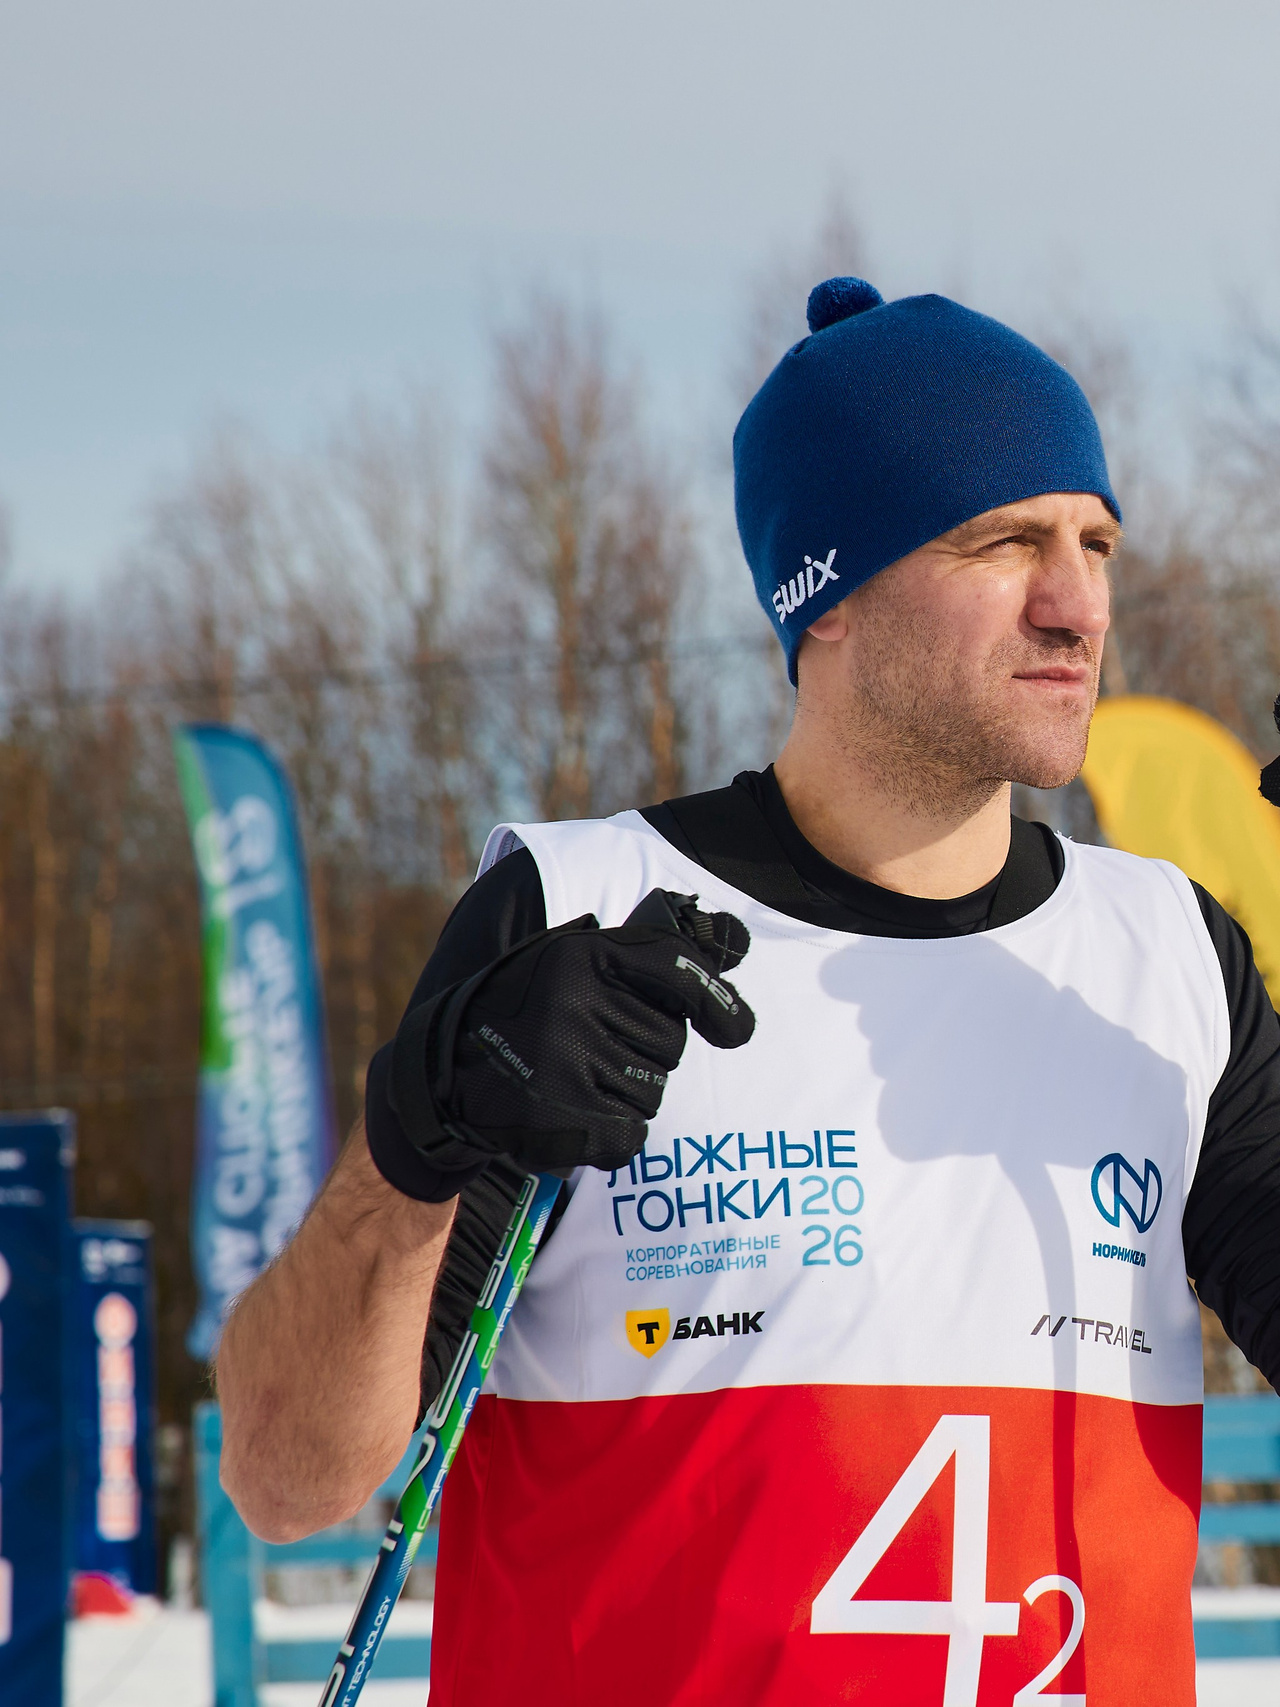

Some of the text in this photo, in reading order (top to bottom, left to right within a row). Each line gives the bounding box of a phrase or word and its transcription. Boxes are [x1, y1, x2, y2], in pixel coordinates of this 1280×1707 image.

[478, 1024, 535, 1080] HEAT Control
[624, 1065, 651, 1081] RIDE
[612, 1174, 865, 1236] ГОНКИ 20
[626, 1234, 781, 1263] КОРПОРАТИВНЫЕ
[626, 1254, 767, 1281] СОРЕВНОВАНИЯ
[801, 1224, 864, 1267] 26
[672, 1311, 766, 1341] БАНК
[1071, 1317, 1152, 1354] TRAVEL
[417, 1243, 536, 1531] CARRERA CARBON
[317, 1331, 480, 1707] PINE
[810, 1413, 1087, 1707] 4 2
[348, 1596, 392, 1692] TECHNOLOGY
